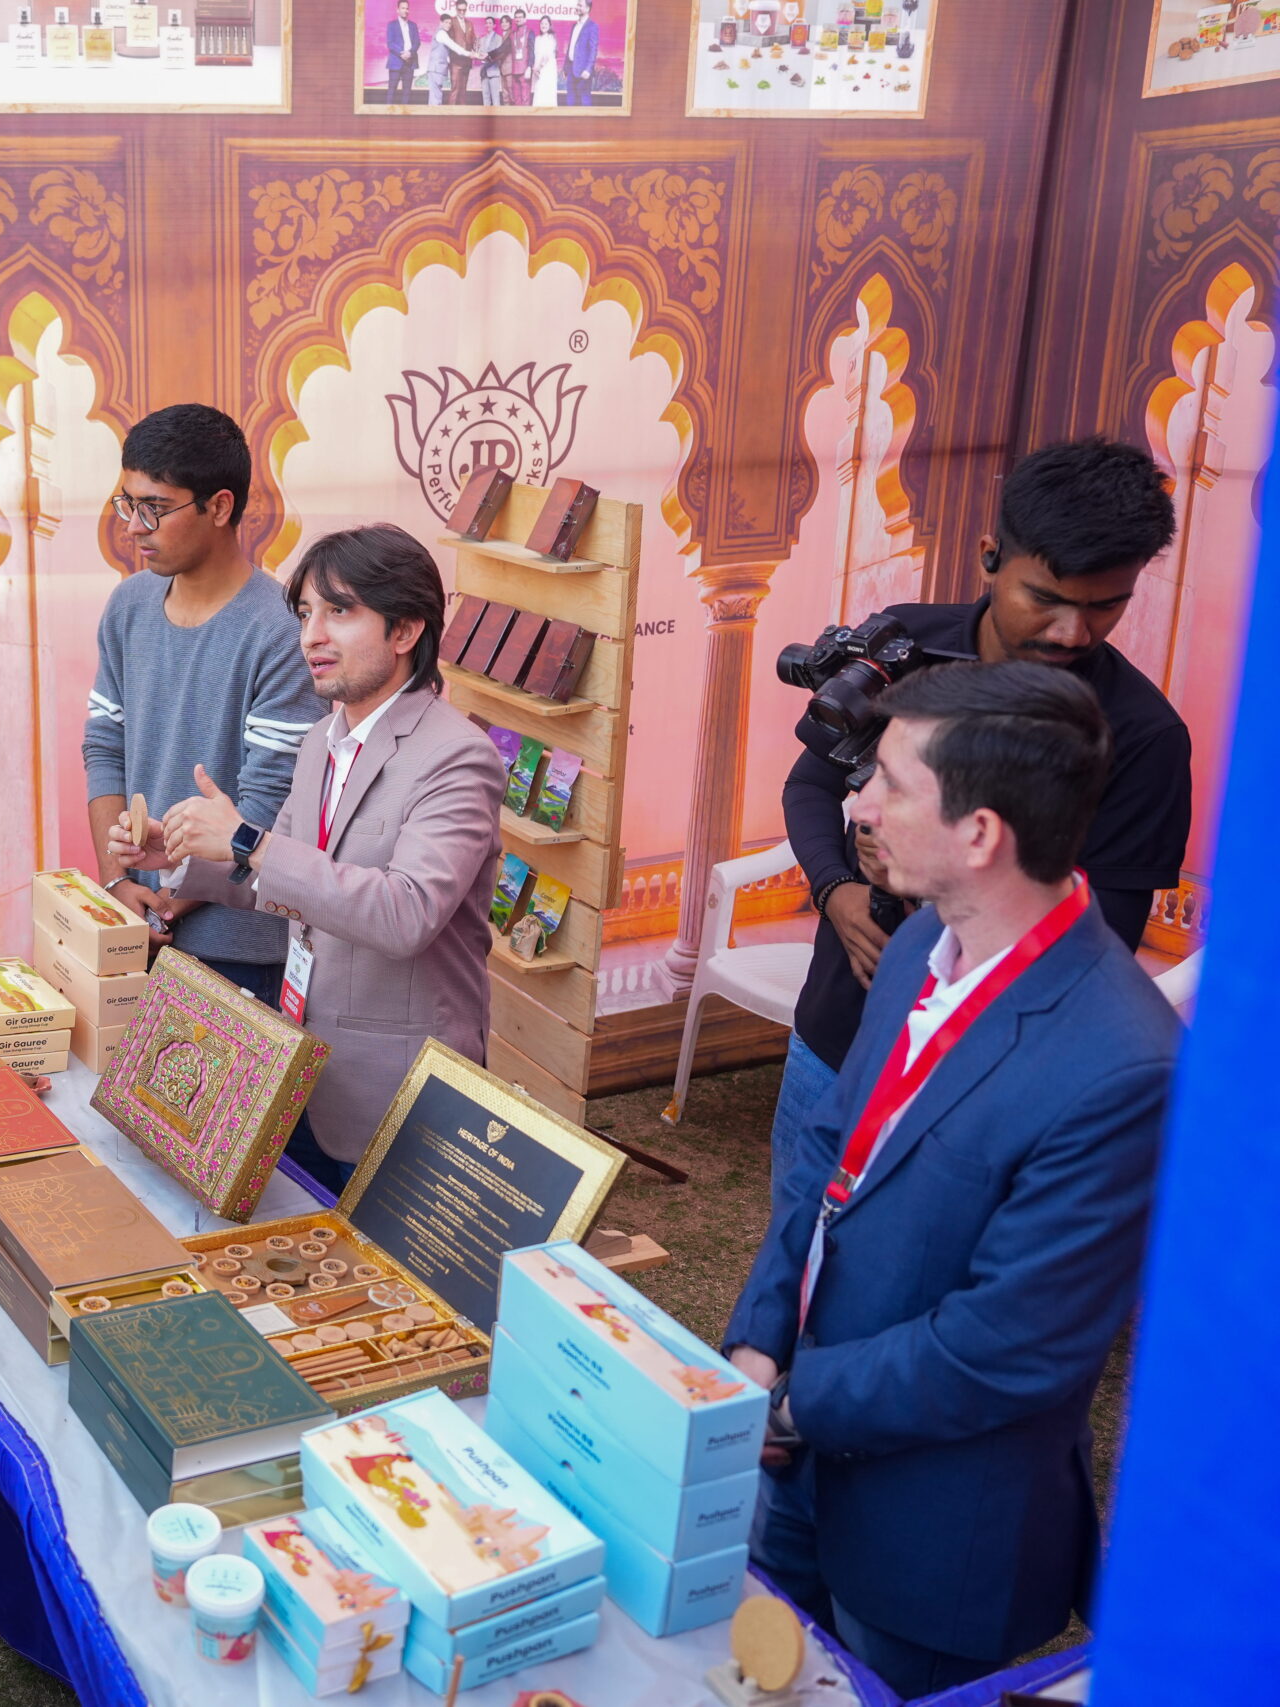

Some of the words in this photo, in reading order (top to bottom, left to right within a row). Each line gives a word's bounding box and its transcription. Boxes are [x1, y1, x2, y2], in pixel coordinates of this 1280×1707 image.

[526, 456, 544, 486] rks
[427, 463, 457, 513] Perfu
[634, 619, 676, 637] ANCE
[118, 995, 139, 1003] Gaure
[5, 1017, 19, 1026] Gir
[20, 1015, 54, 1024] Gauree
[13, 1039, 48, 1048] Gauree
[11, 1059, 45, 1069] Gauree
[458, 1127, 490, 1153] HERITAGE
[488, 1147, 499, 1158] OF
[497, 1153, 516, 1171] INDIA
[462, 1446, 509, 1489] Pushpan
[490, 1571, 556, 1604] Pushpan
[494, 1606, 560, 1638] Pushpan
[486, 1637, 553, 1669] Pushpan
